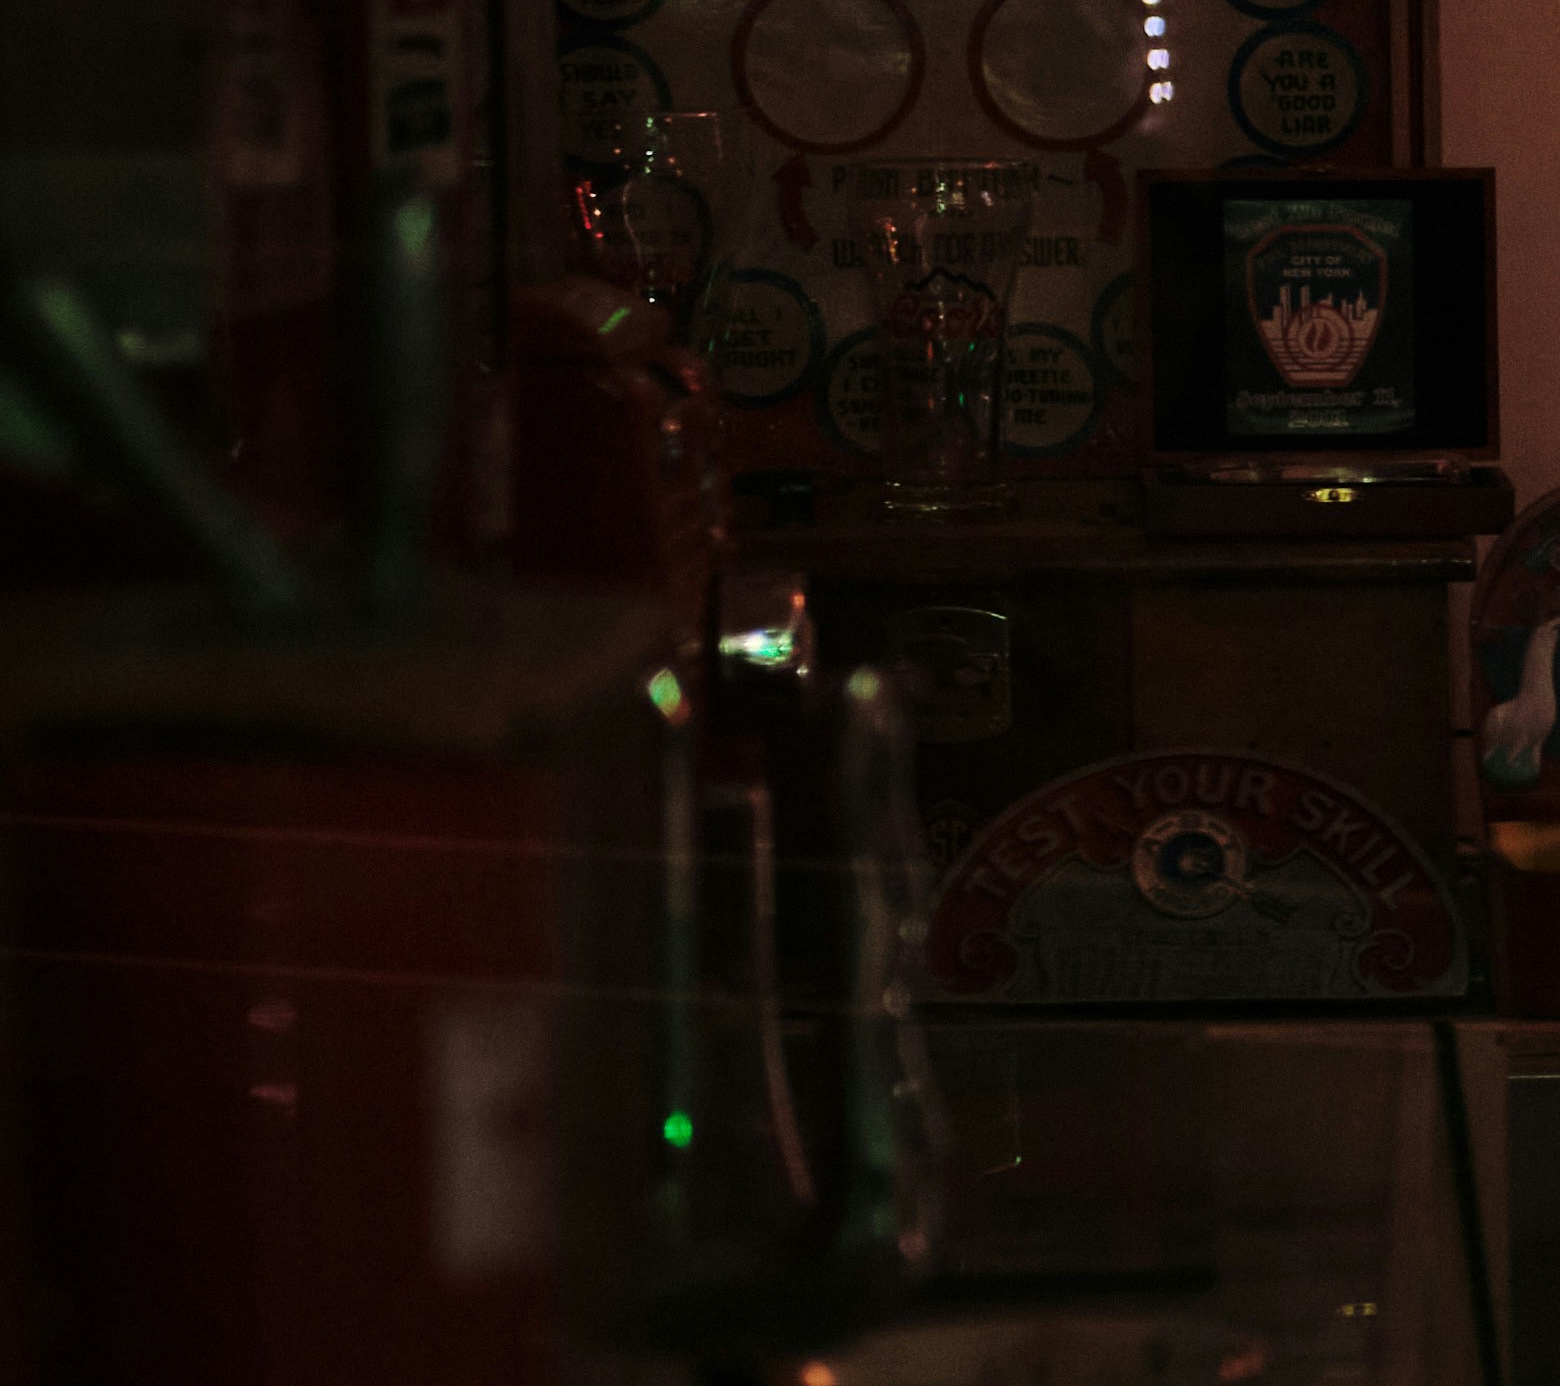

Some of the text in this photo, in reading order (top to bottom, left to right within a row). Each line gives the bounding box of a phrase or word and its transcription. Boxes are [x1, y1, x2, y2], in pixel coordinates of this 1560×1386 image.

[1273, 50, 1329, 68] ARE
[1260, 69, 1309, 93] YOU
[1276, 94, 1337, 112] GOOD
[1281, 115, 1333, 134] LIAR
[1291, 255, 1343, 266] CITY OF
[1282, 268, 1352, 278] NEW YORK
[962, 790, 1091, 900] TEST
[1111, 762, 1279, 816] YOUR
[1290, 785, 1419, 912] SKILL
